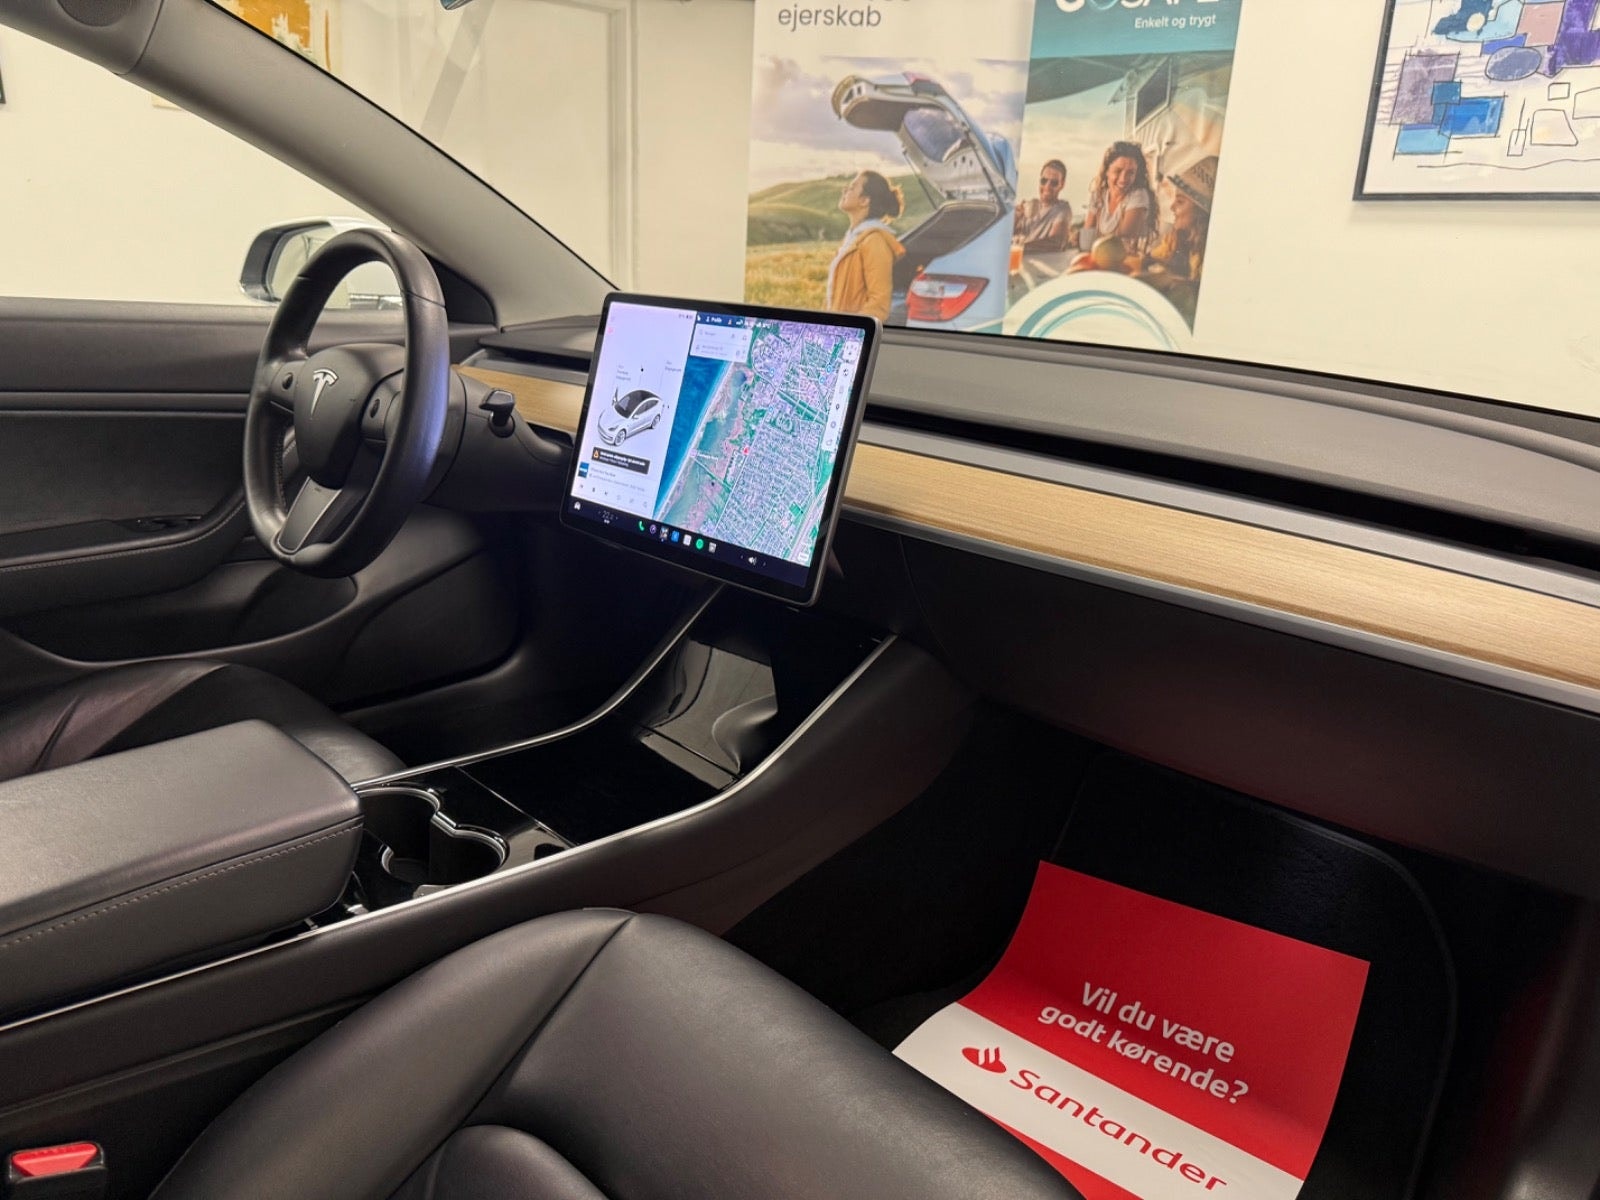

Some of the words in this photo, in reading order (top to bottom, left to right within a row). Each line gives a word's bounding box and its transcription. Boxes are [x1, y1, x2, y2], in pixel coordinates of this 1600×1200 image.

[778, 4, 882, 32] ejerskab
[1134, 16, 1169, 29] Enkelt
[1171, 17, 1186, 29] og
[1189, 14, 1217, 28] trygt
[1037, 1006, 1107, 1043] godt
[1106, 1030, 1249, 1104] kørende?
[1081, 981, 1118, 1014] Vil
[1118, 1001, 1156, 1031] du
[1162, 1018, 1235, 1063] være
[1009, 1069, 1227, 1190] Santander
